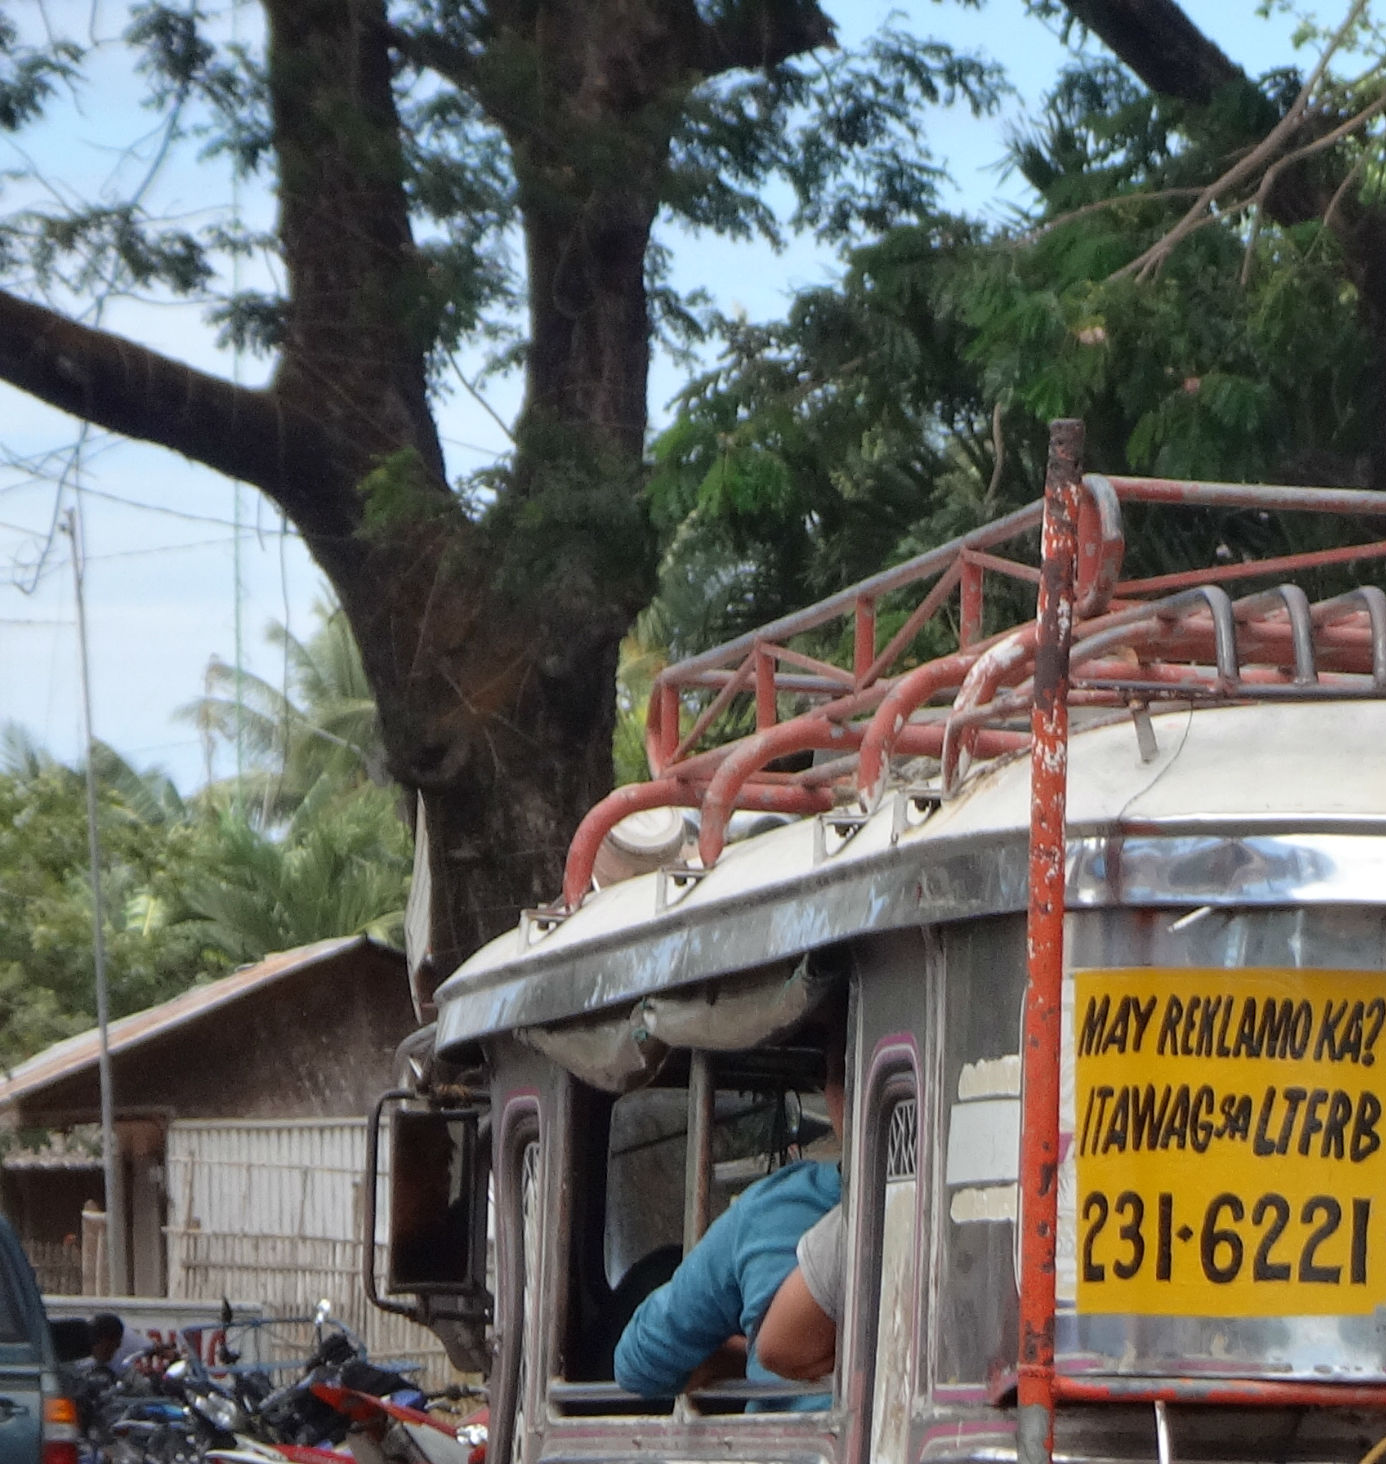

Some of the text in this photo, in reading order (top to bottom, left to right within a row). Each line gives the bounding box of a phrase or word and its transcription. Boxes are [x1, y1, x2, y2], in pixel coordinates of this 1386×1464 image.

[1077, 993, 1386, 1067] MAY REKLAMO KA?
[1079, 1083, 1215, 1156] ITAWAG
[1252, 1085, 1383, 1163] LTFRB
